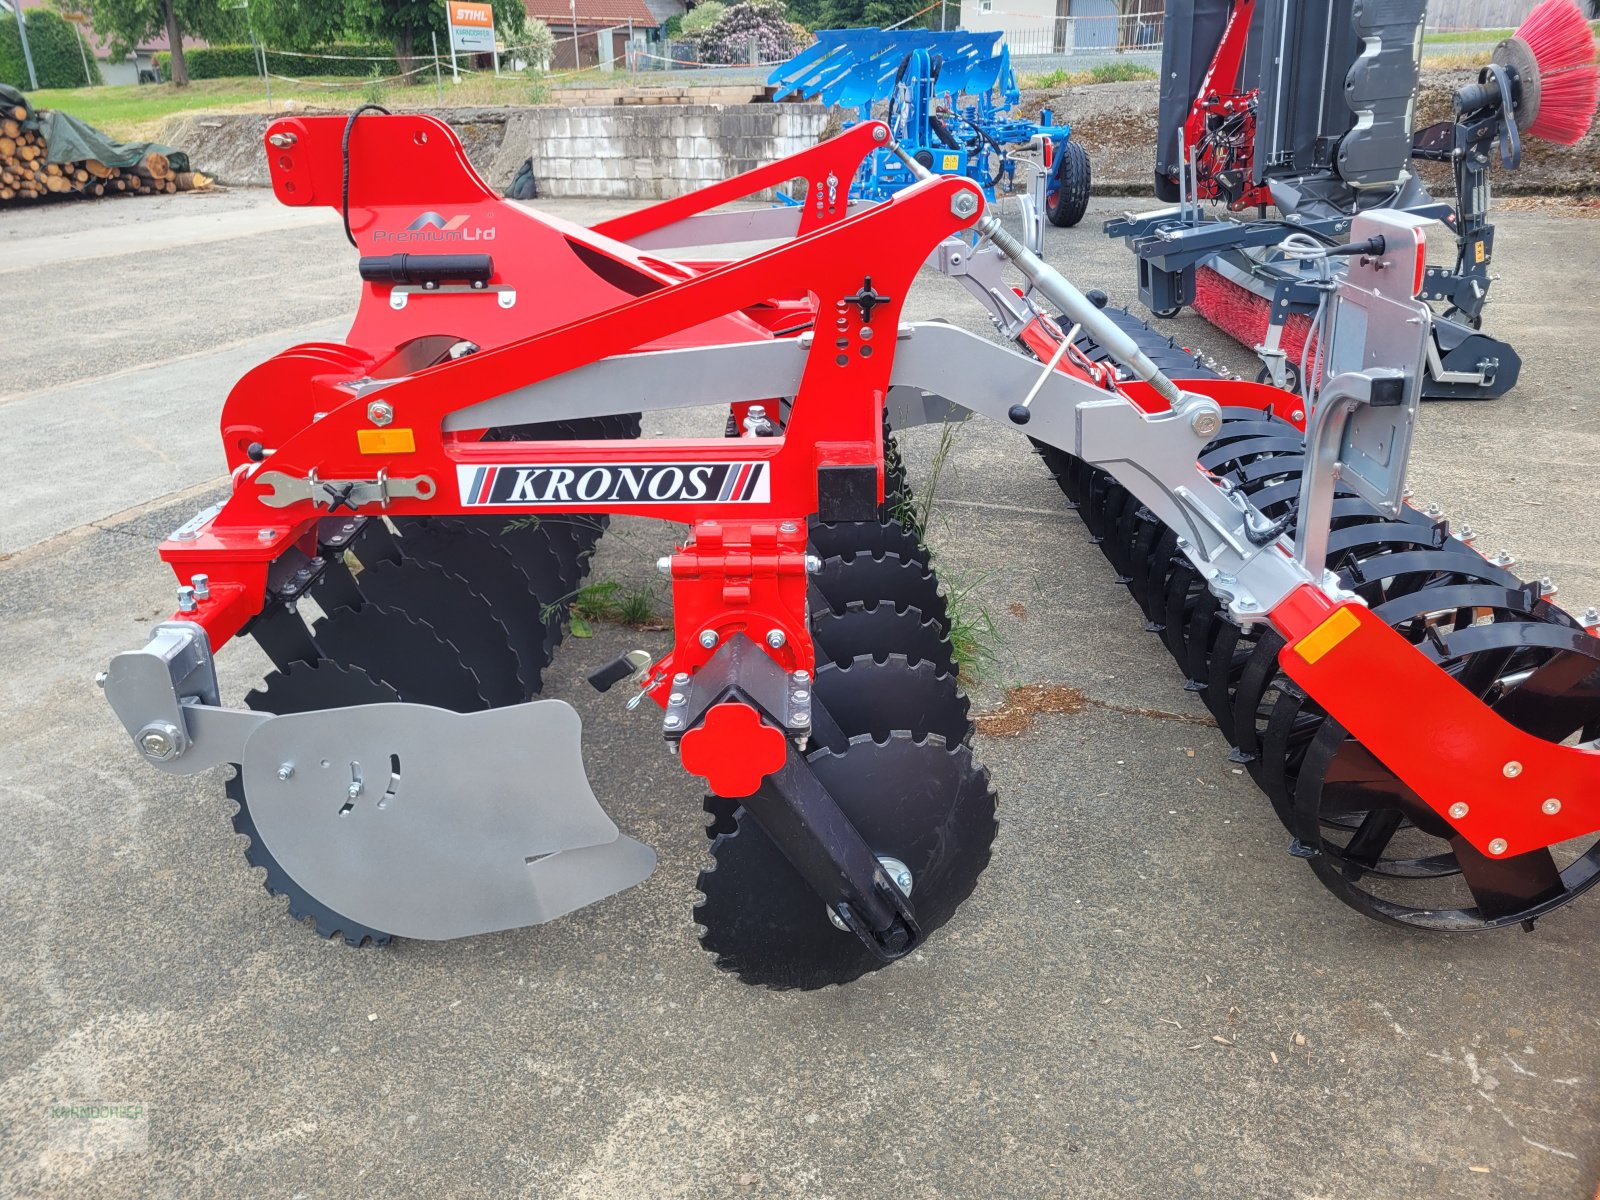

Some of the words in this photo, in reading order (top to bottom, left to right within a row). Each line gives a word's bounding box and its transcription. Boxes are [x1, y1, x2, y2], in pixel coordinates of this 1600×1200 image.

[456, 9, 488, 21] STIHL
[373, 227, 496, 242] PremiumLtd
[506, 466, 715, 502] KRONOS
